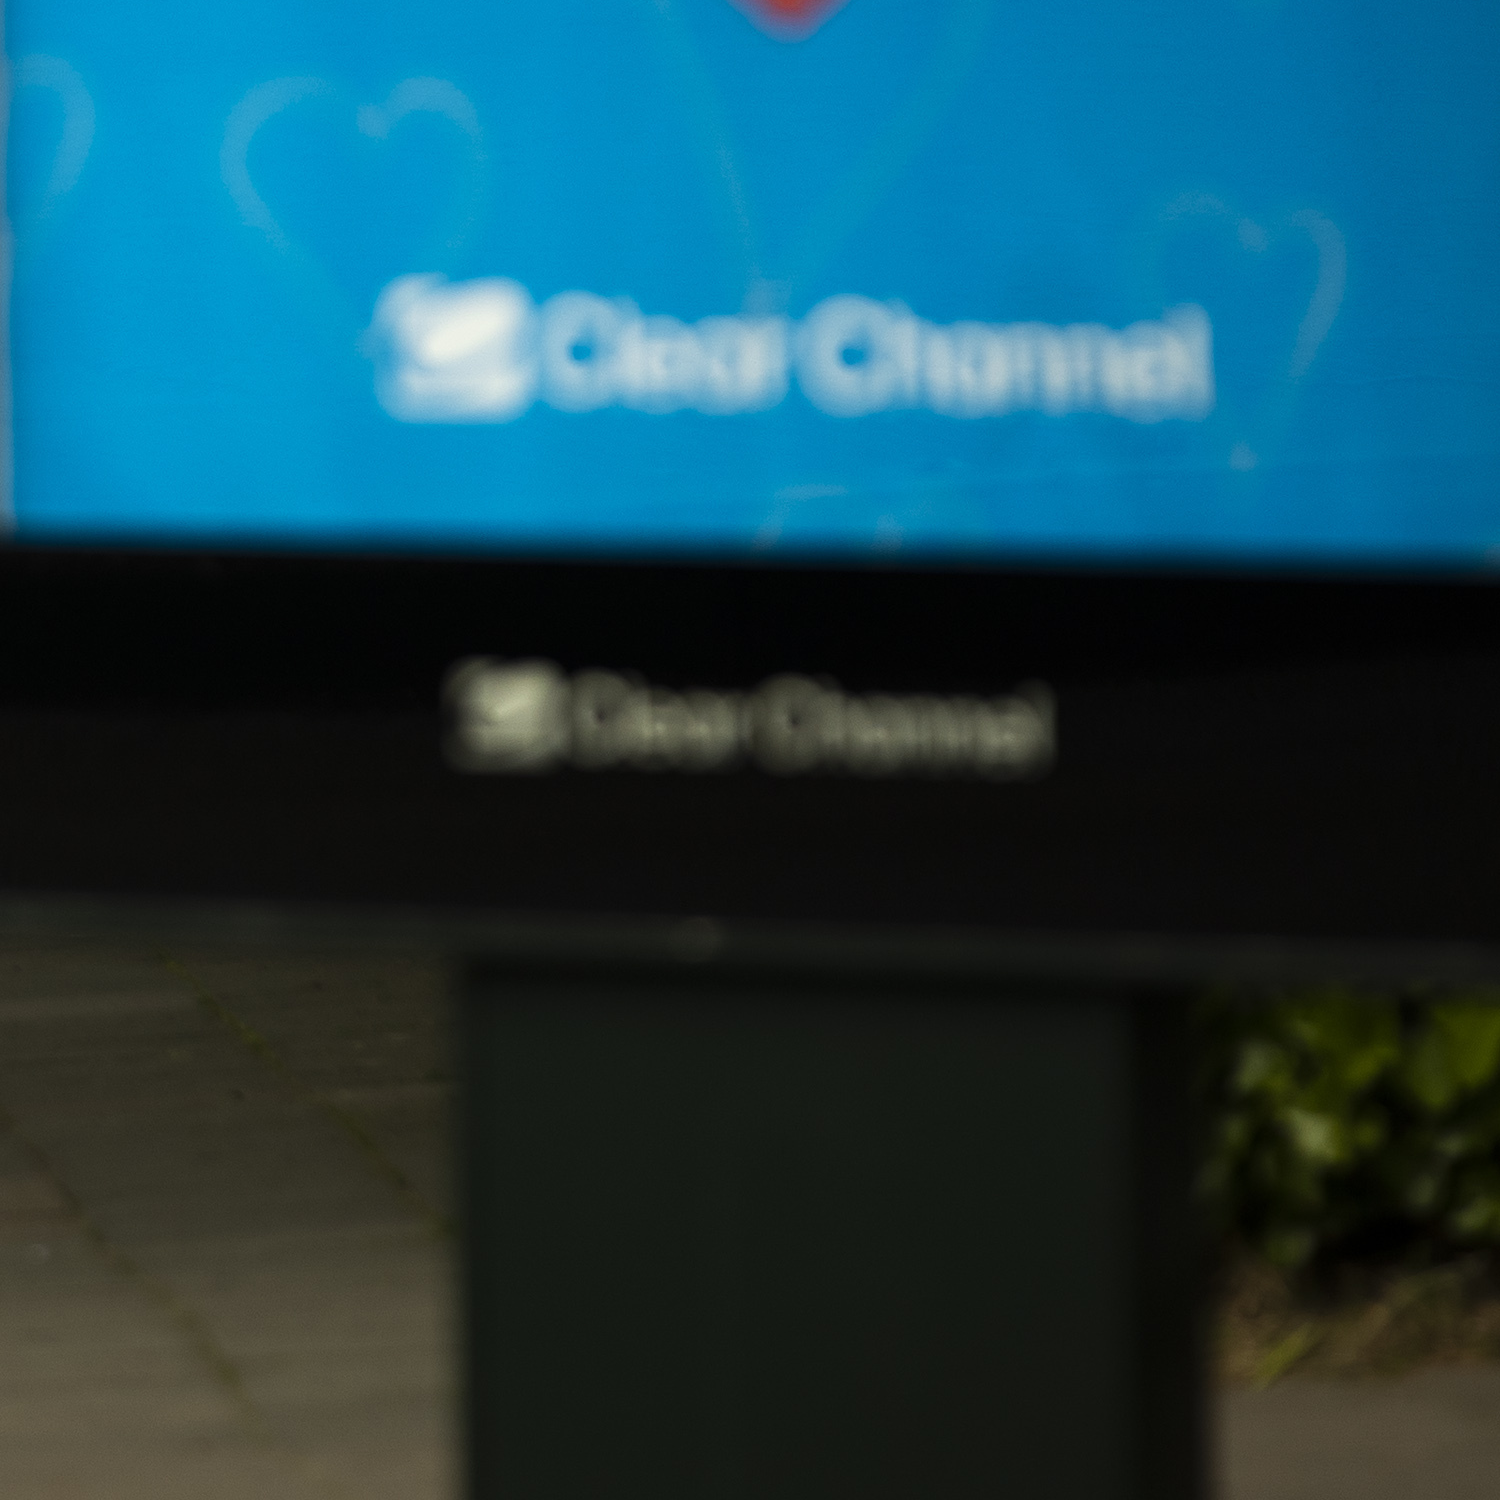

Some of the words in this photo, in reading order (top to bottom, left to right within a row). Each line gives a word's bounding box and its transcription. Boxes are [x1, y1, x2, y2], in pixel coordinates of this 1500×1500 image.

[542, 292, 788, 412] Clear
[801, 295, 1213, 421] Channel
[572, 670, 745, 771] Clear
[753, 674, 1056, 779] Channel
